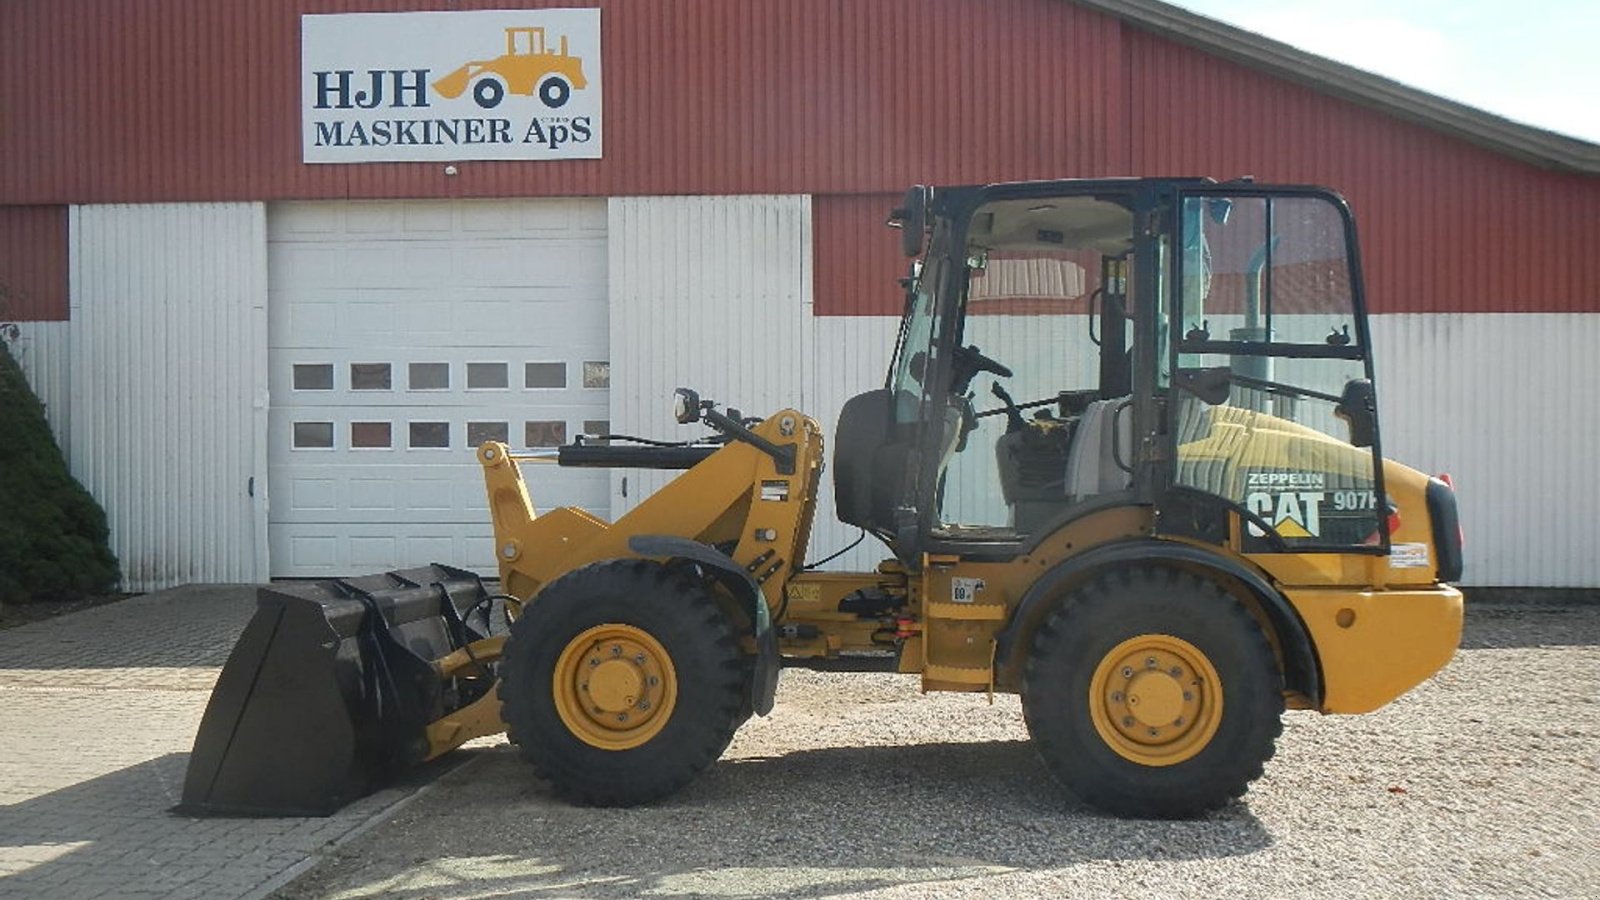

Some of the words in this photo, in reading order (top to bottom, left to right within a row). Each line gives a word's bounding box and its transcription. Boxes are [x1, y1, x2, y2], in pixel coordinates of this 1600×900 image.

[312, 69, 431, 109] HJH
[314, 117, 514, 146] MASKINER
[522, 116, 592, 149] ApS
[1248, 473, 1323, 484] ZEPPELIN
[1246, 492, 1324, 538] CAT
